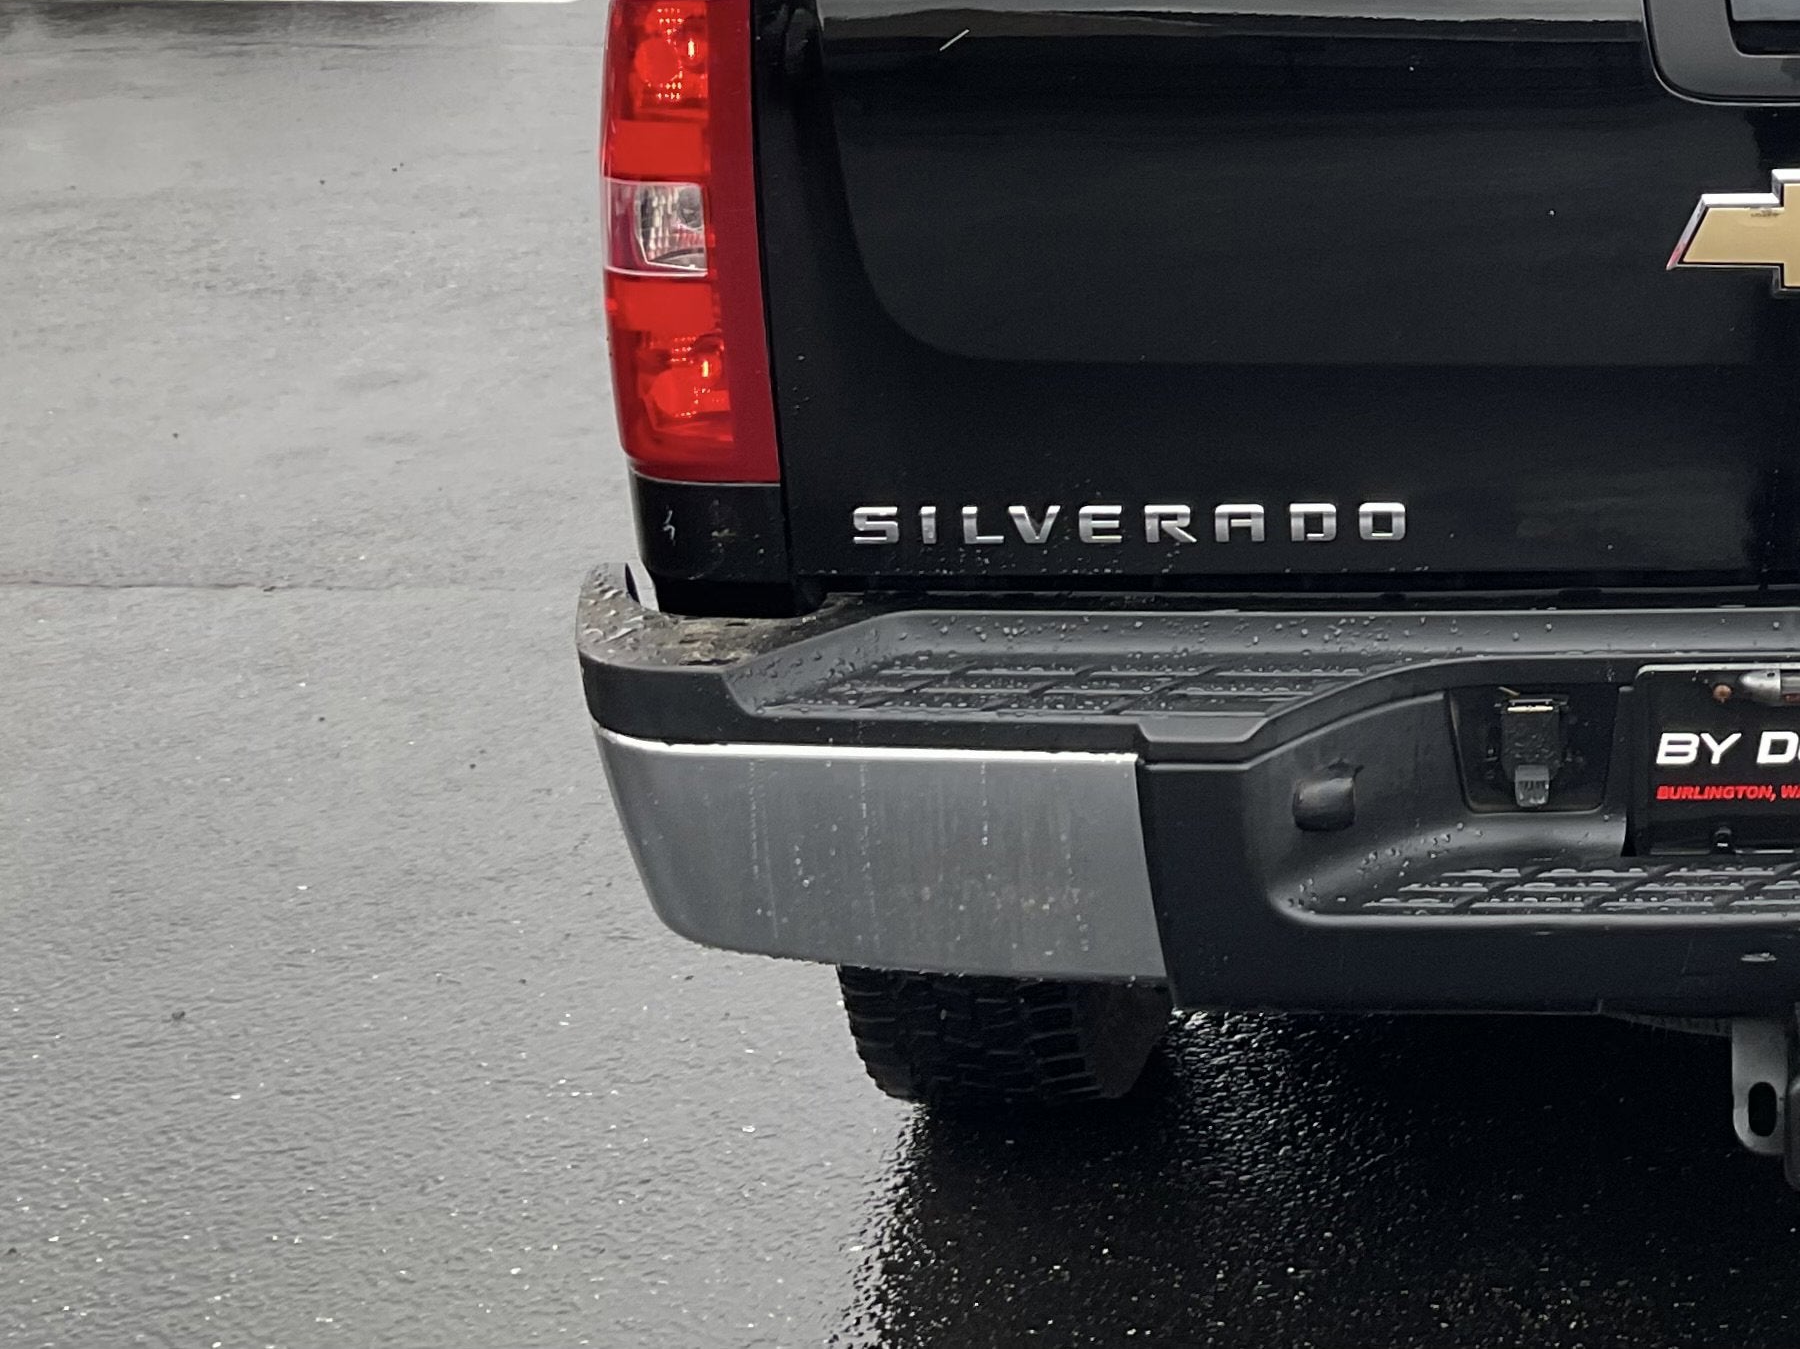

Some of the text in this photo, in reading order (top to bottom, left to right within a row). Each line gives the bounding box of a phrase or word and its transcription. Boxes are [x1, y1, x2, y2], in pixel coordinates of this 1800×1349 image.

[852, 502, 1407, 546] SILVERADO
[1656, 731, 1742, 765] BY
[1656, 784, 1776, 802] BURLINGTON,
